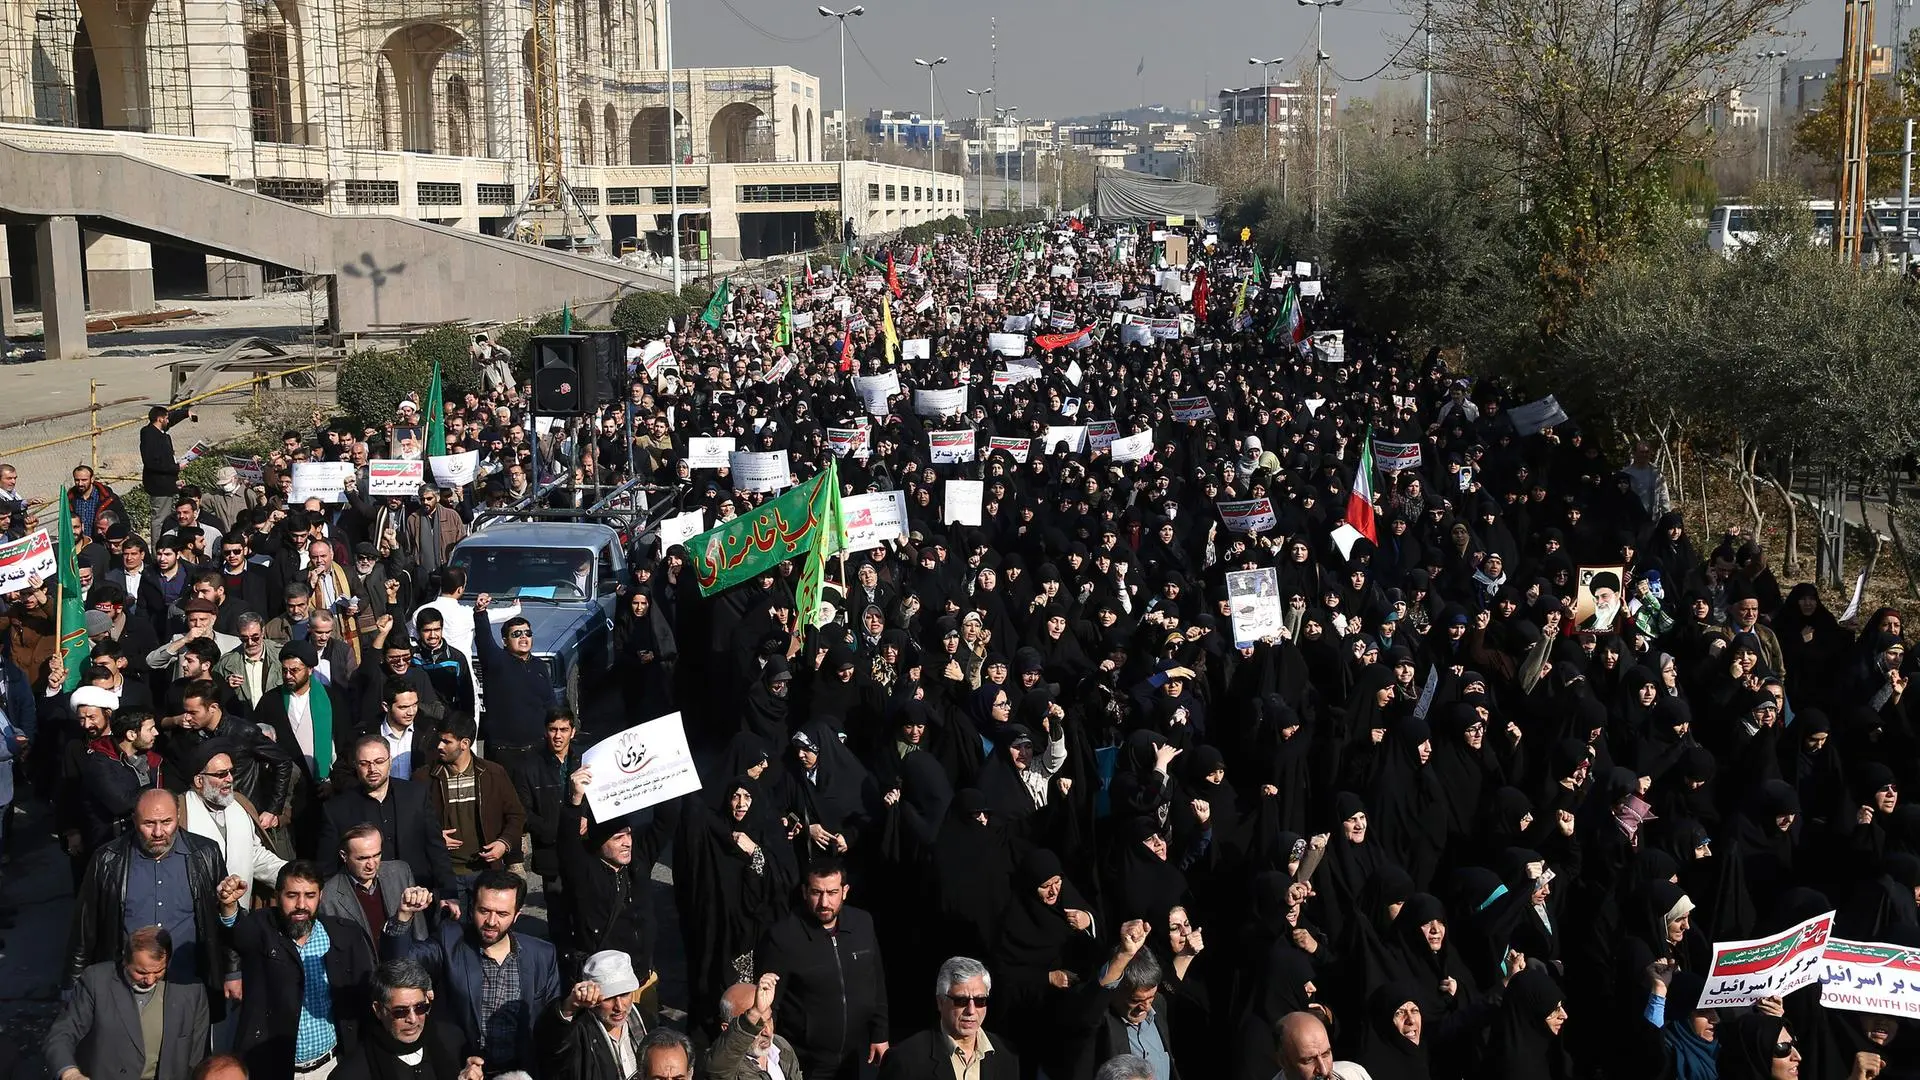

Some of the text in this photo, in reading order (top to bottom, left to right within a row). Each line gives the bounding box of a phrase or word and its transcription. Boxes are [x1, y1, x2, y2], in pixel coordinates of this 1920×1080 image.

[371, 479, 397, 488] اسرائیل
[38, 558, 54, 571] مرگ
[8, 567, 26, 580] فتنه
[1709, 956, 1819, 996] مرگ بر اسرائیل
[1817, 965, 1883, 989] اسرائیل
[1889, 979, 1905, 994] بر
[1704, 996, 1746, 1006] DOWN
[1865, 996, 1901, 1010] WITH
